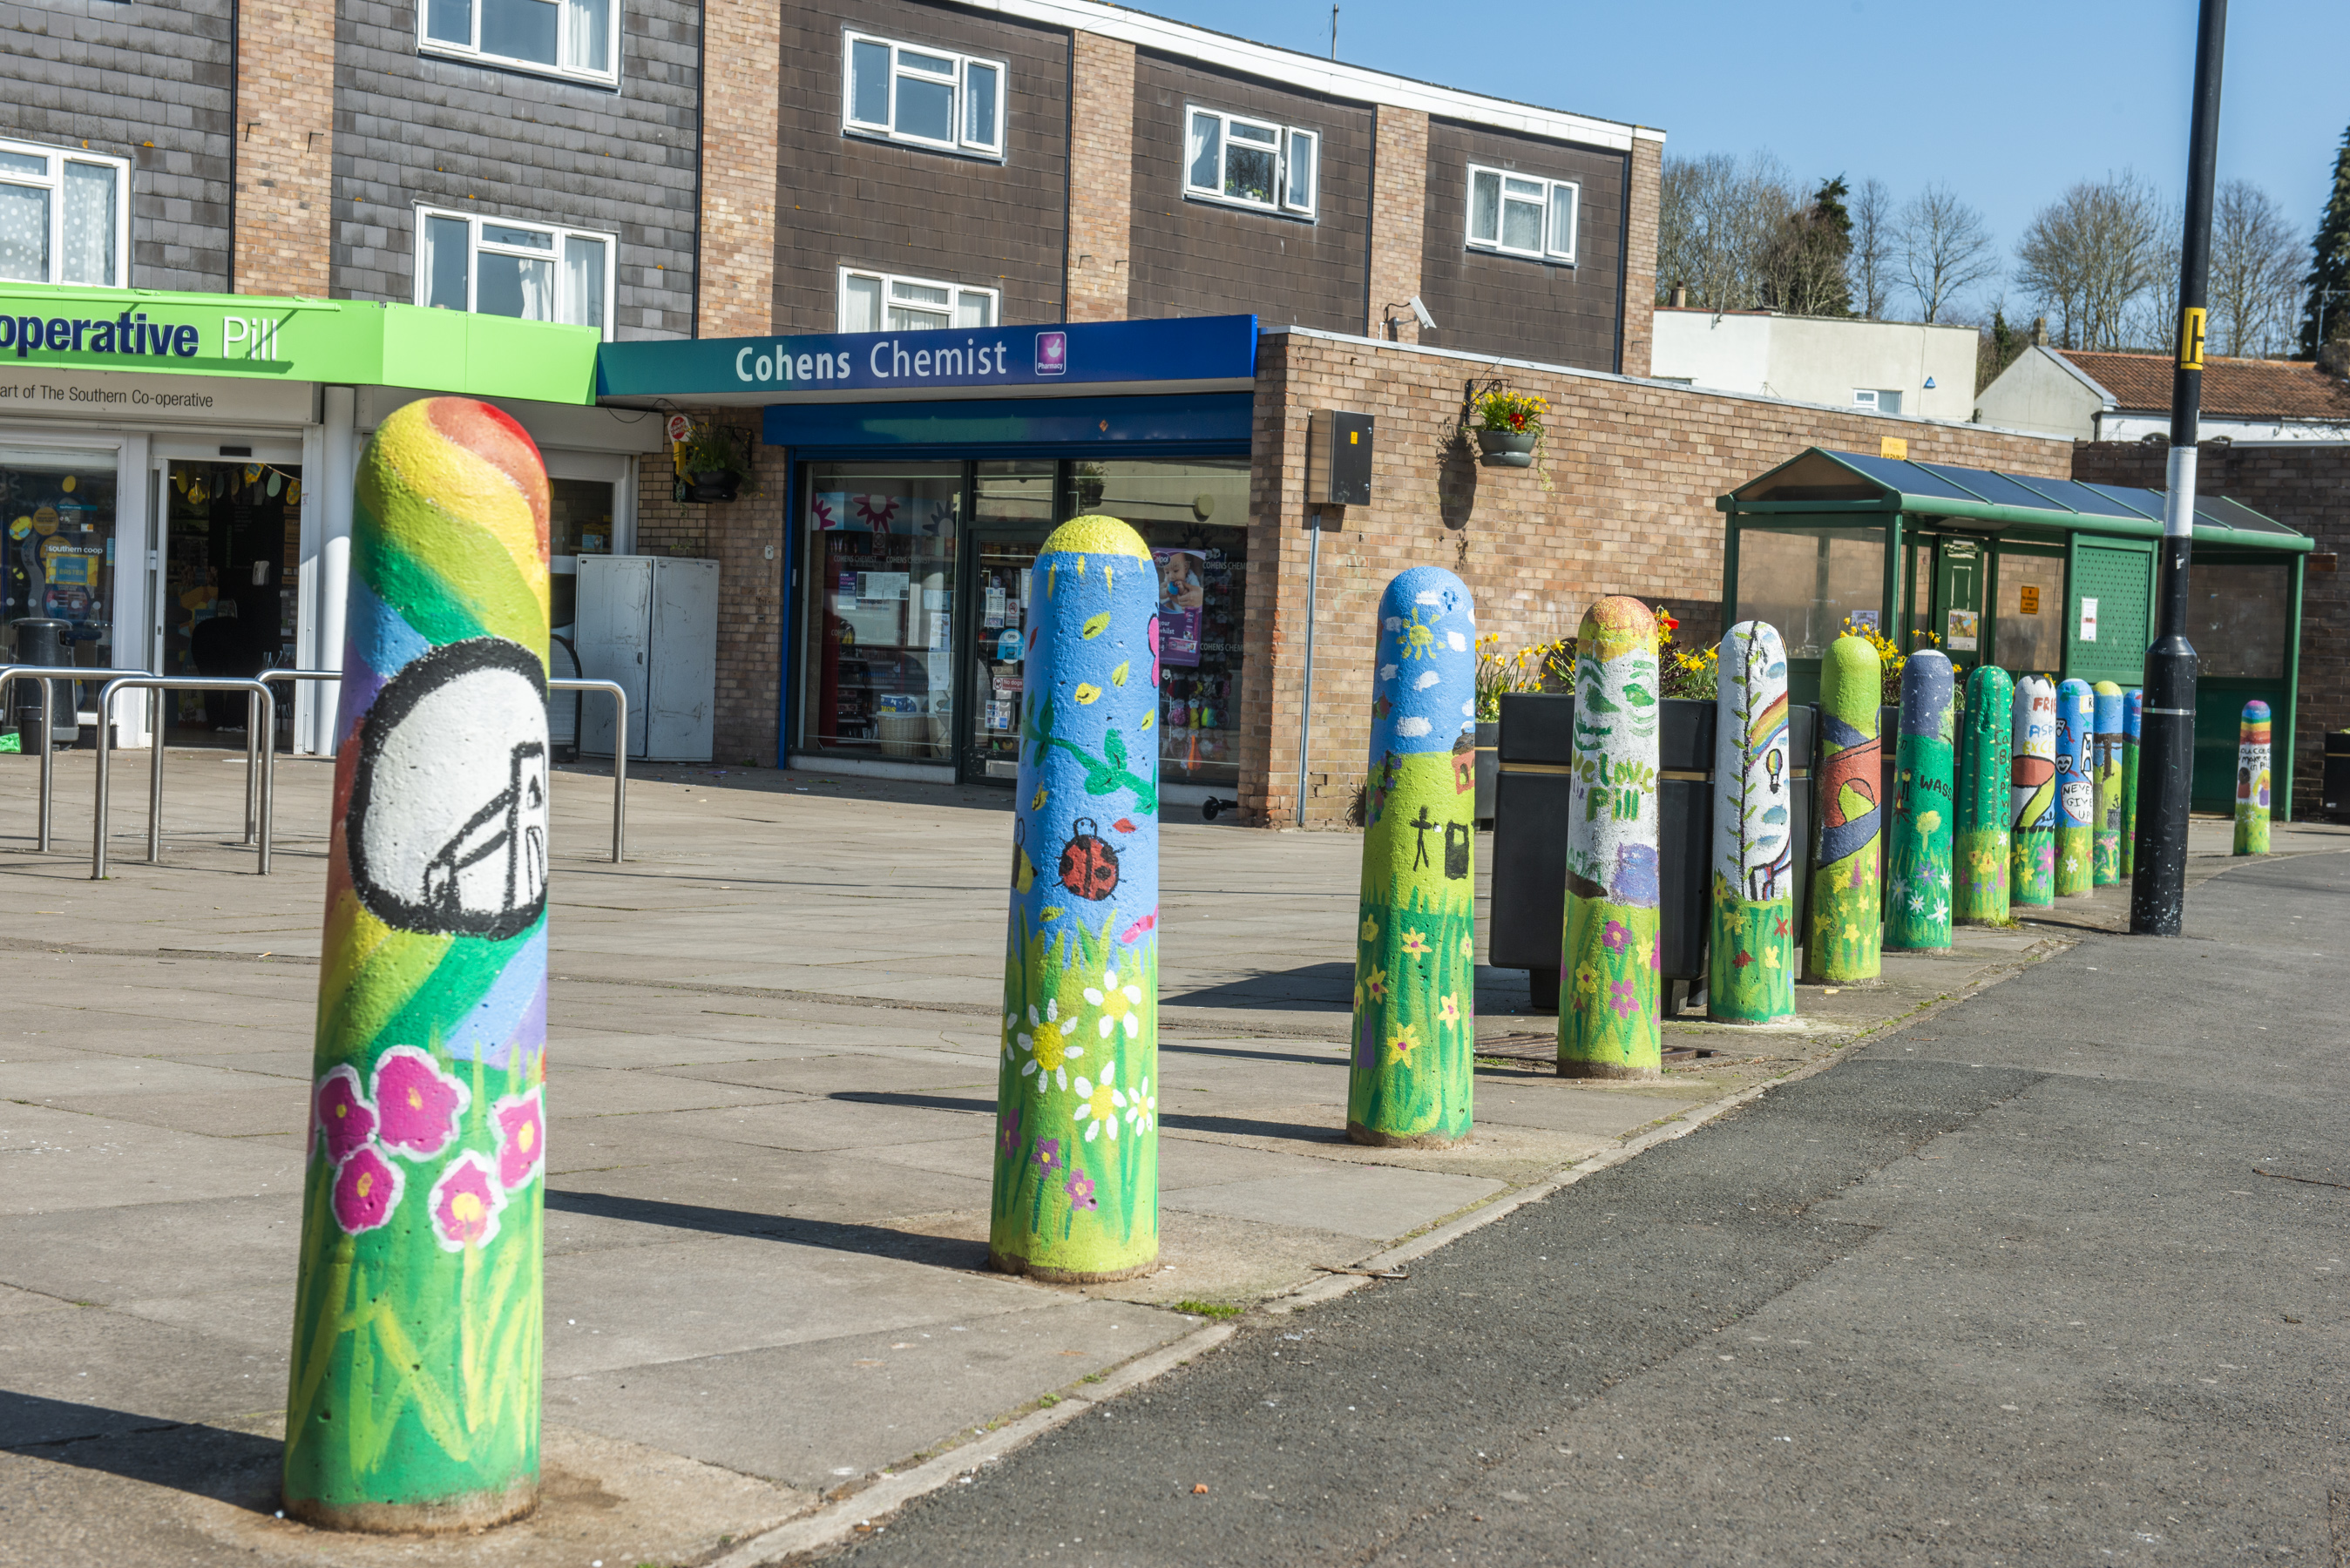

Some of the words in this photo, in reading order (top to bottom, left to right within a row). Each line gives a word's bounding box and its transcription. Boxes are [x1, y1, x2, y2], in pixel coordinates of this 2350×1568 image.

[223, 315, 278, 362] Pill
[735, 344, 850, 382] Cohens
[870, 338, 1007, 378] Chemist
[1038, 362, 1064, 370] Pharmacy
[0, 384, 18, 397] art
[23, 384, 36, 398] of
[40, 385, 64, 400] The
[69, 386, 127, 403] Southern
[132, 389, 213, 408] Co-operative
[48, 544, 82, 553] southern
[1200, 642, 1224, 651] COHENS
[1920, 774, 1953, 801] WASS
[2062, 784, 2093, 795] NEVE
[1586, 786, 1640, 822] Pill
